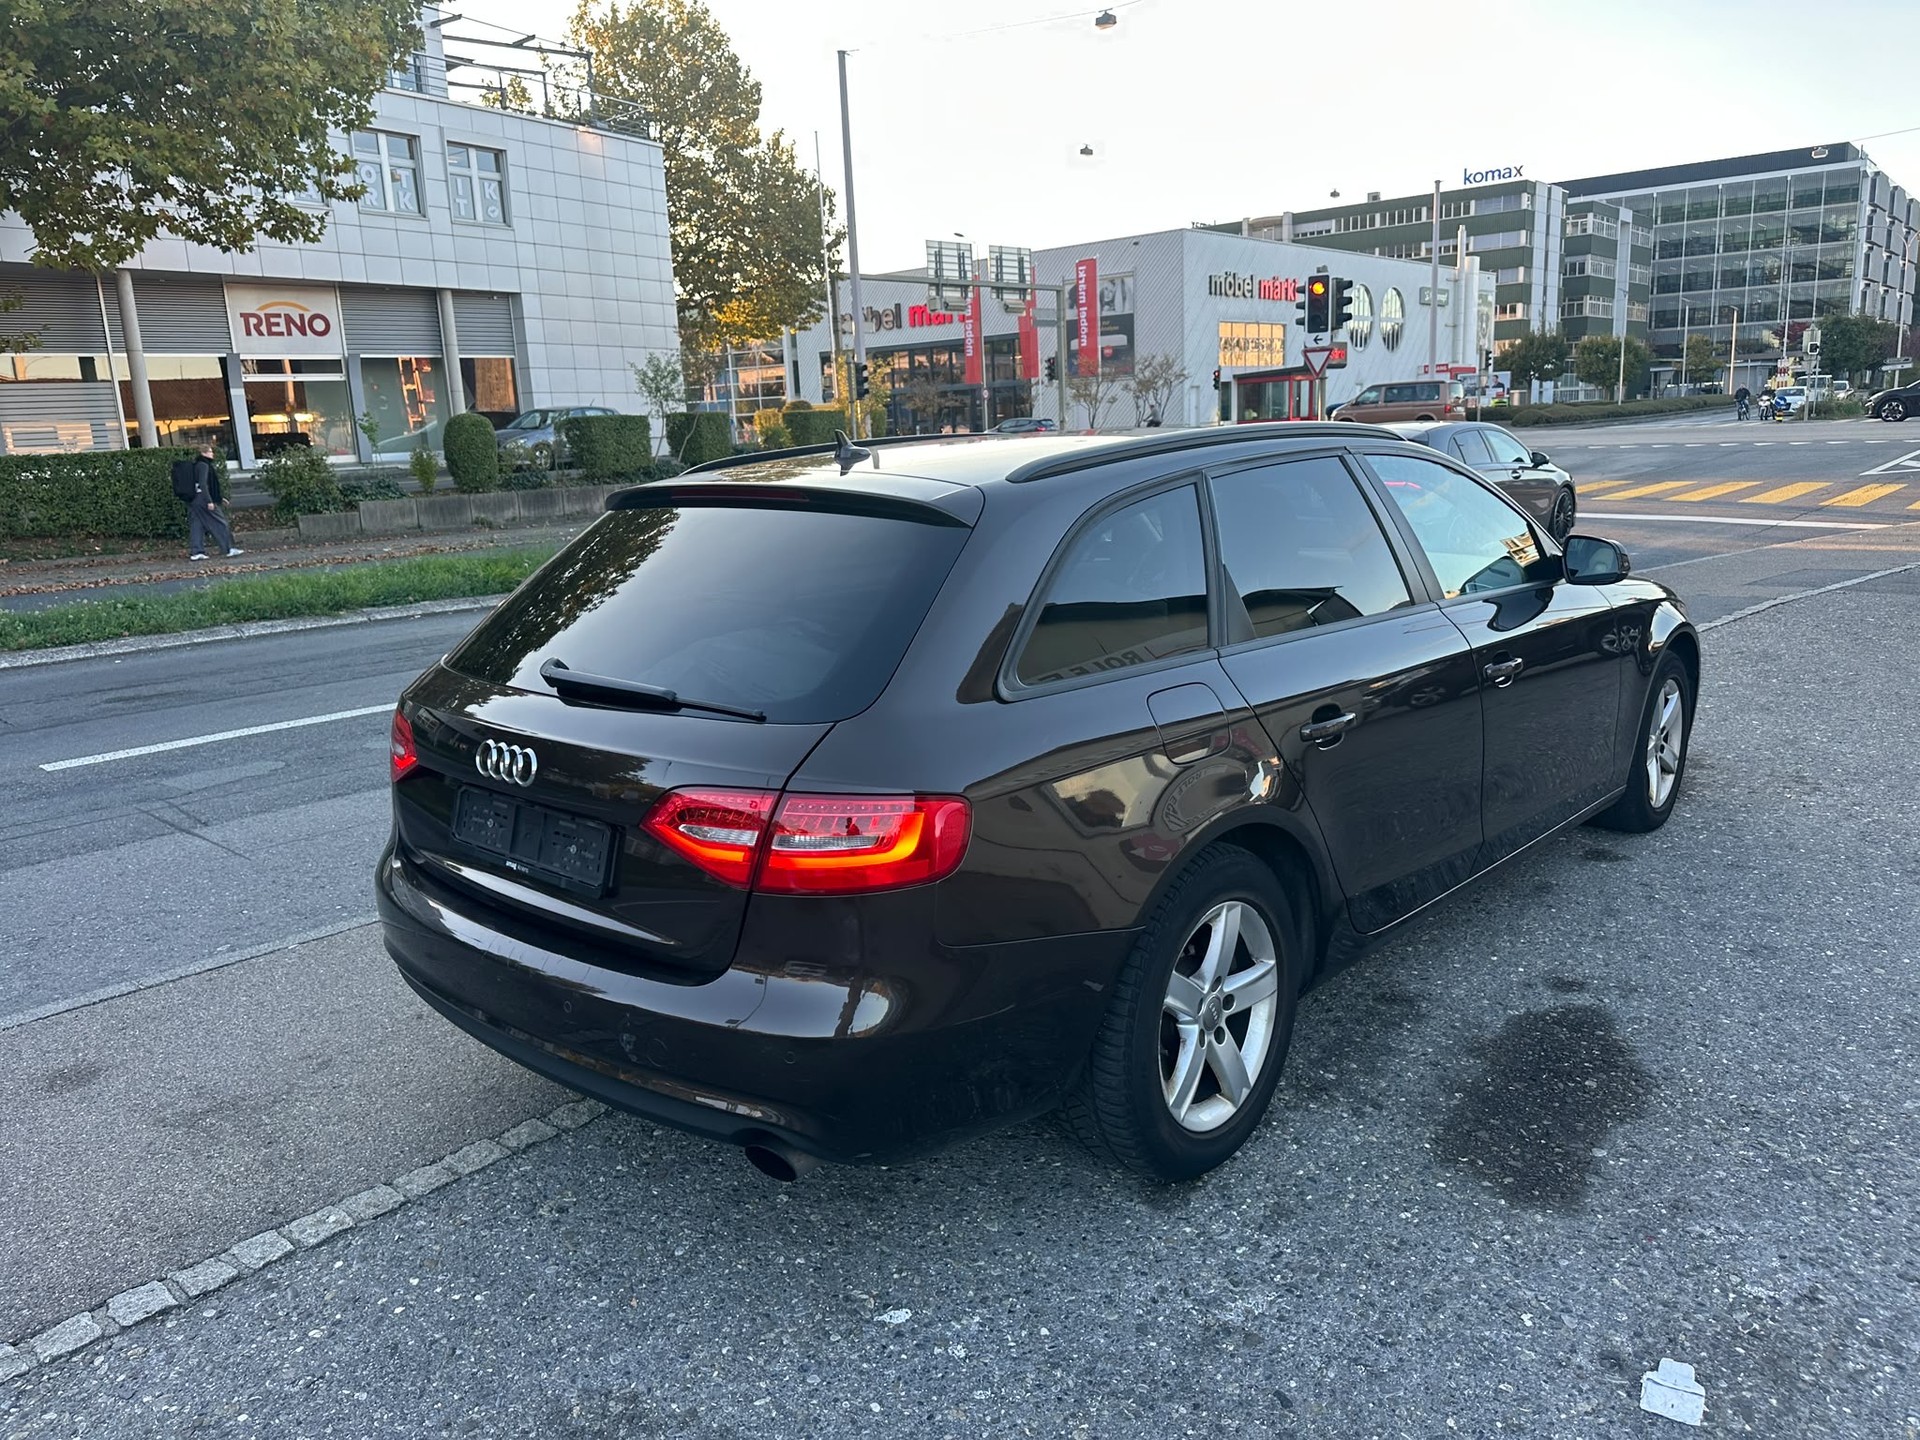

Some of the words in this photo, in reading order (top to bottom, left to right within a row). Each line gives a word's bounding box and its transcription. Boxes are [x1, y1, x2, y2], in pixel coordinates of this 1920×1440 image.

[359, 164, 499, 200] OTIK
[1463, 165, 1524, 185] komax
[1208, 271, 1254, 298] möbel
[240, 313, 331, 337] RENO
